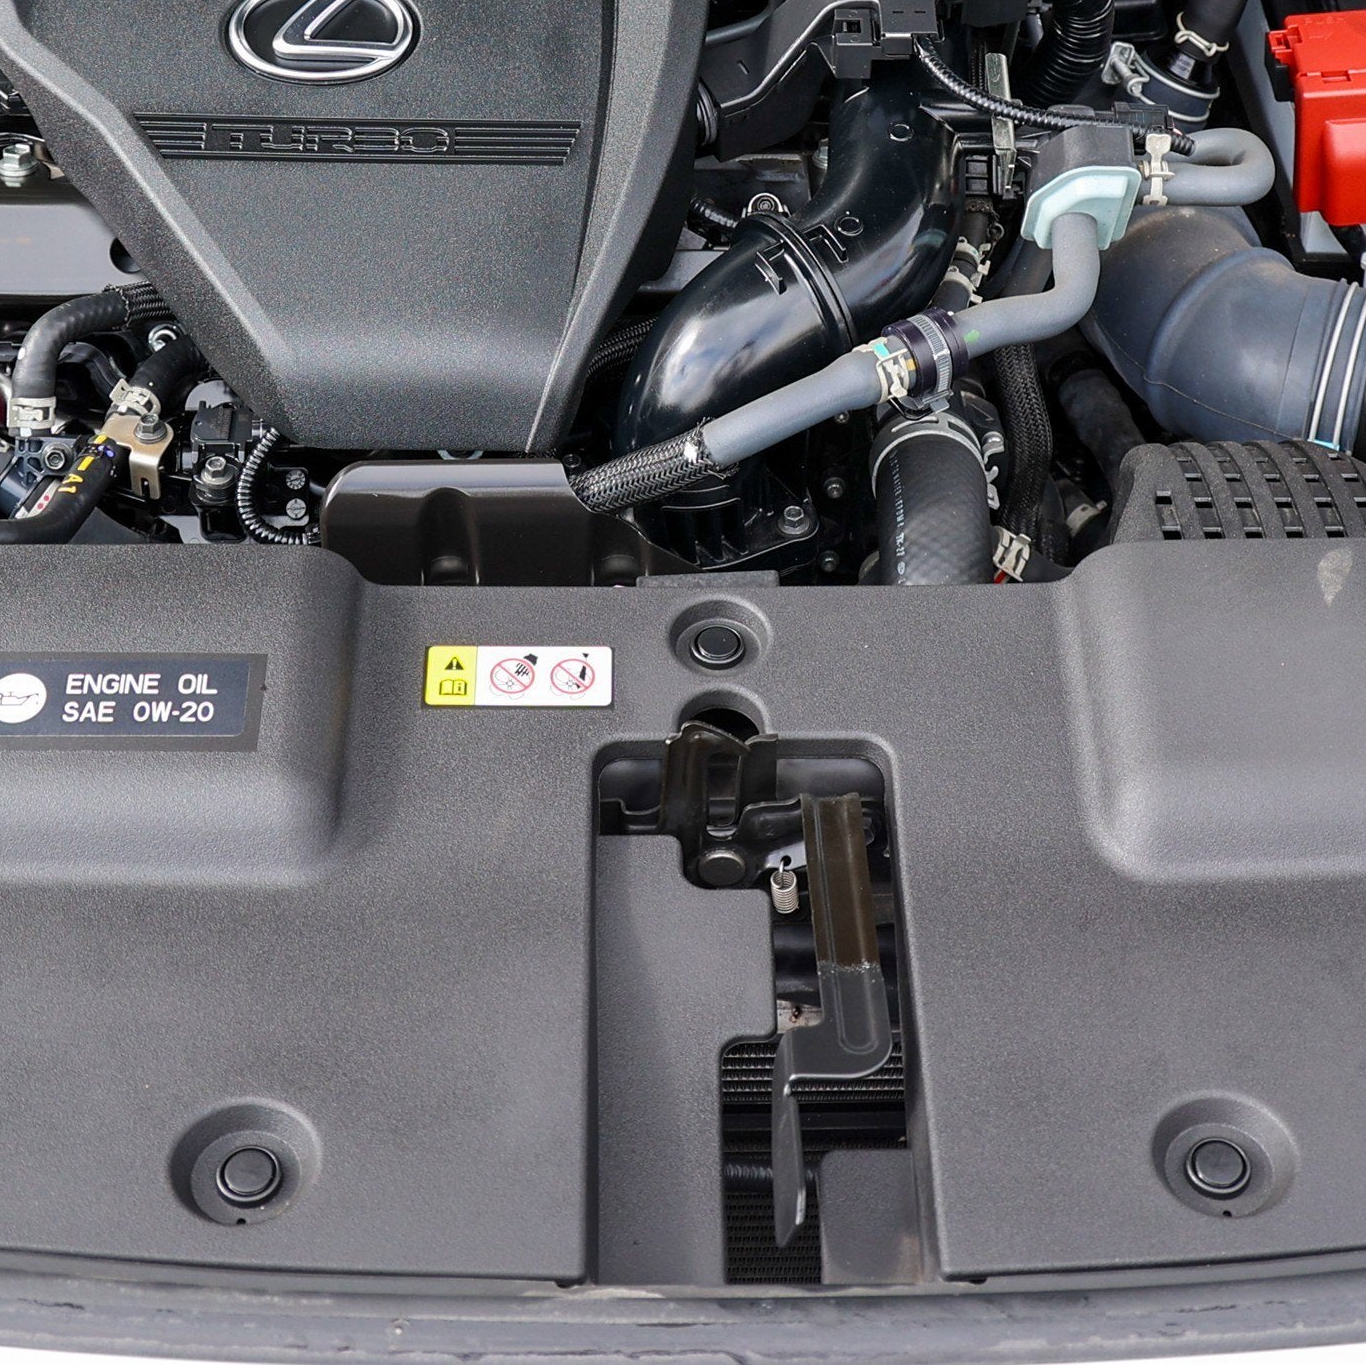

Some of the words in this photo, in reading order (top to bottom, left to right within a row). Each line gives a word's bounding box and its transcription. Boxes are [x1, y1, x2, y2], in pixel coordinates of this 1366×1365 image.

[210, 124, 455, 153] TURBO
[65, 673, 160, 695] ENGINE
[177, 673, 219, 695] OIL
[62, 701, 115, 723] SAE
[132, 701, 216, 723] 0W-20
